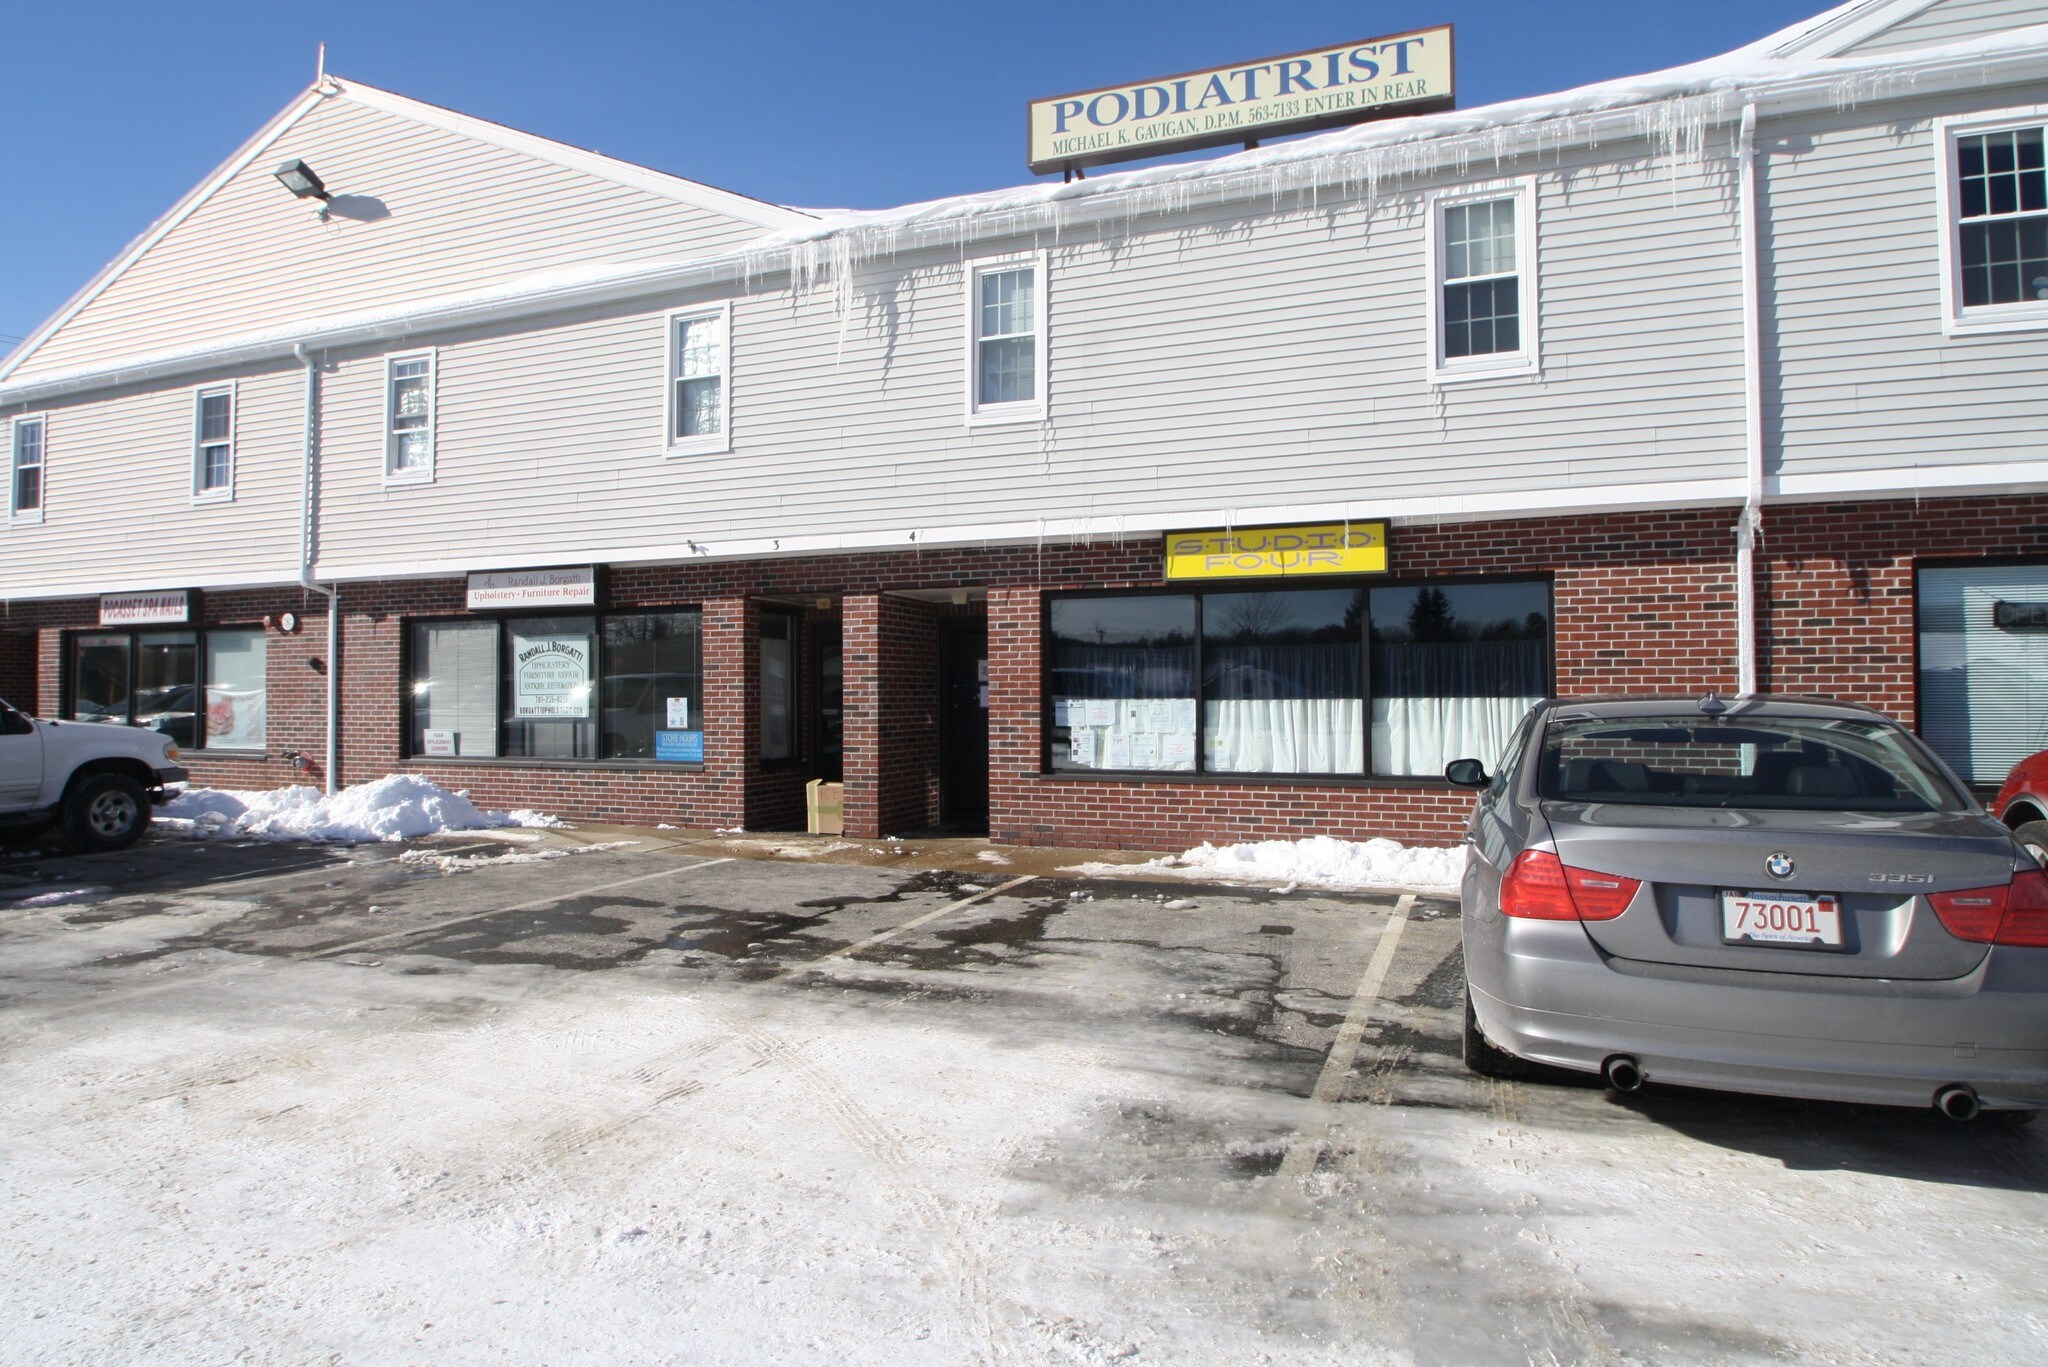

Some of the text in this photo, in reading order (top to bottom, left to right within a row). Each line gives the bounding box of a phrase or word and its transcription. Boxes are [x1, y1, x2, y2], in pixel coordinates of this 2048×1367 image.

[1051, 37, 1425, 135] PODIATRIST
[1052, 132, 1114, 156] MICHAEL
[1117, 128, 1131, 144] K.
[1204, 111, 1244, 131] D.P.M.
[1248, 100, 1300, 122] 563-7133
[1304, 93, 1356, 114] ENTER
[1360, 88, 1378, 105] IN
[1383, 79, 1428, 101] REAR
[773, 540, 780, 550] 3
[908, 531, 916, 542] 4
[1205, 550, 1342, 571] FOUR
[508, 573, 581, 587] Randall J. Borgatti
[474, 586, 590, 602] Upholstery Furniture Repair
[103, 595, 185, 619] POCASSET SPA NAILS
[1998, 604, 2048, 624] OPE
[519, 644, 545, 663] RANDALL
[552, 641, 584, 662] BORGATTI
[523, 671, 555, 679] FURNITURE
[531, 661, 571, 669] UPHOLSTERY
[1735, 902, 1821, 933] 73001
